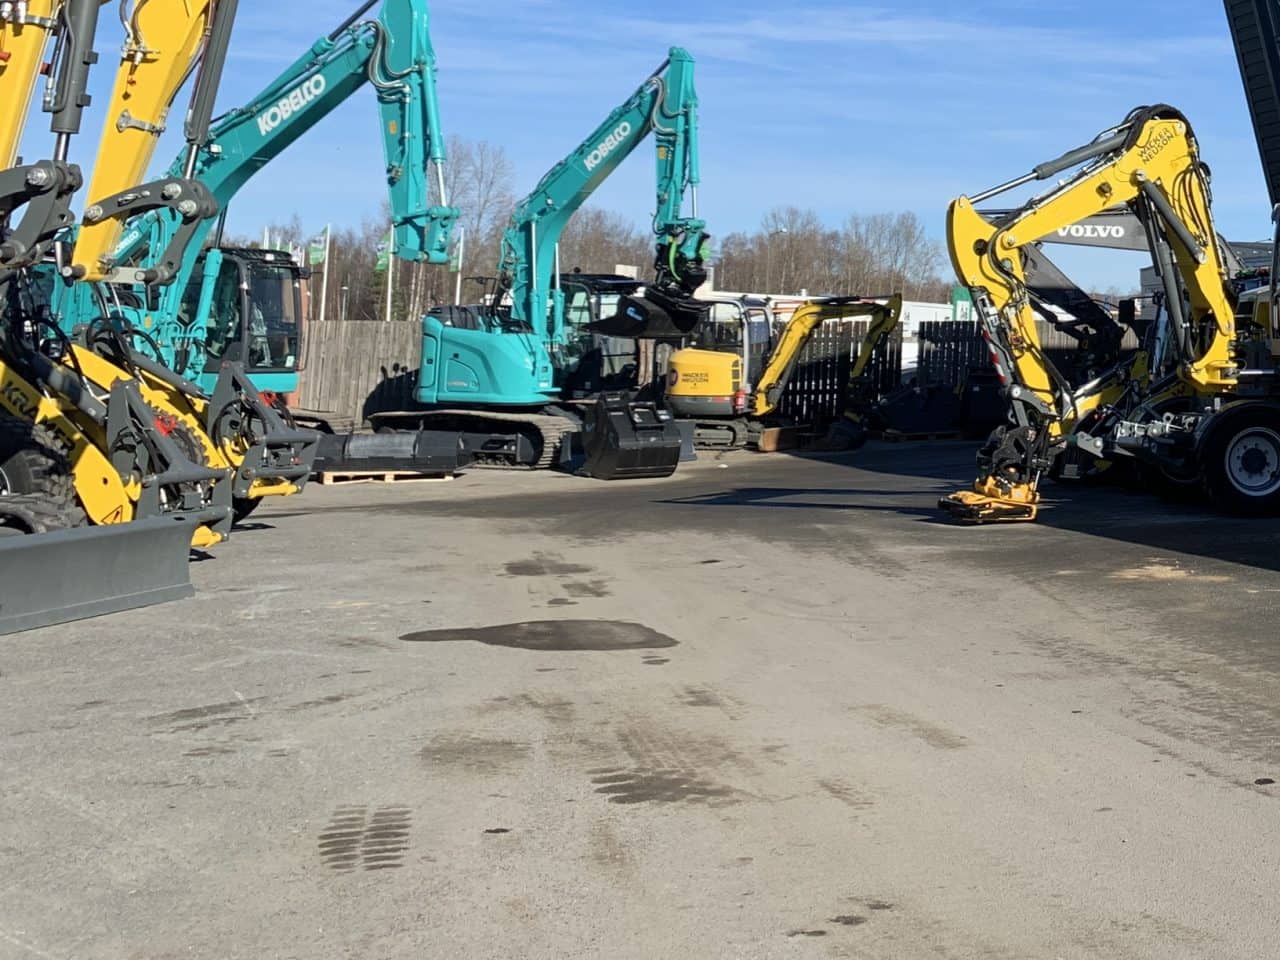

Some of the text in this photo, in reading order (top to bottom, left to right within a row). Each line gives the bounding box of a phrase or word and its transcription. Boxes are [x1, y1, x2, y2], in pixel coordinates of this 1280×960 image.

[257, 74, 326, 136] KOBELCO
[584, 122, 631, 171] KOBELCO
[1138, 128, 1169, 157] WACKER
[1142, 132, 1174, 164] NEUSON
[1057, 224, 1126, 238] VOLVO
